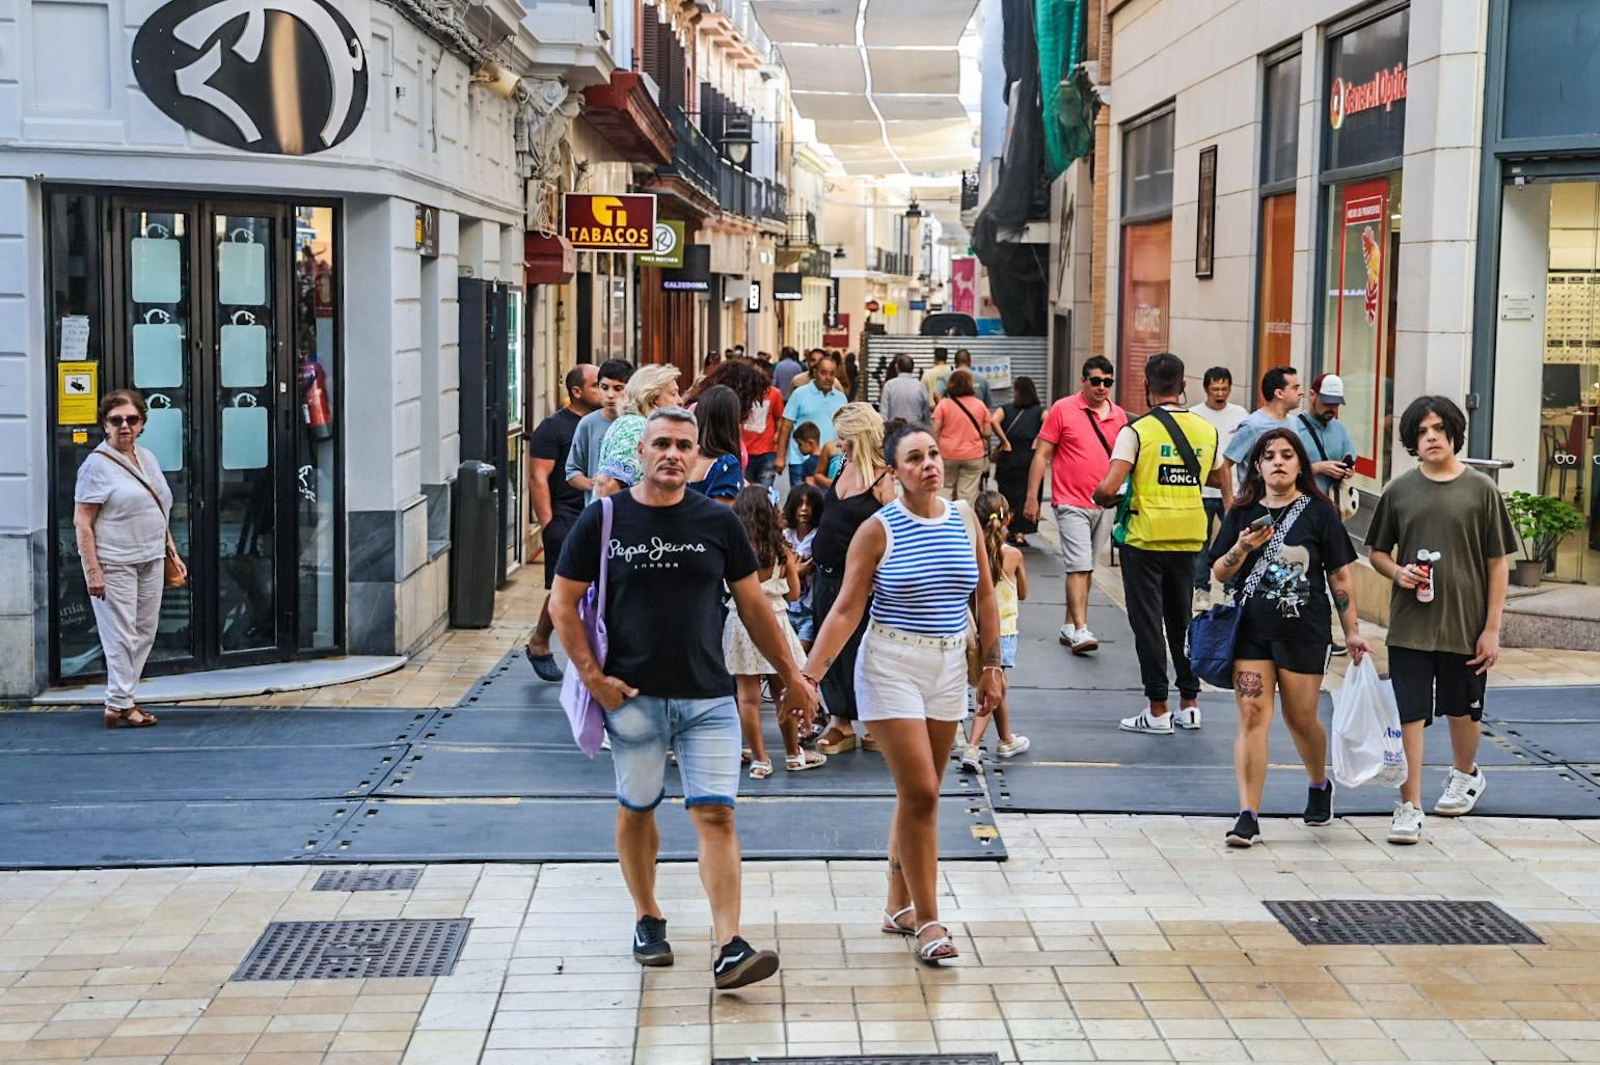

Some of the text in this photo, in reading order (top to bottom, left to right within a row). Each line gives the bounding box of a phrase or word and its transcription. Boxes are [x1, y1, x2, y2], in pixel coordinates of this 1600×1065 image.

[1345, 72, 1379, 115] General
[569, 227, 649, 244] TABACOS
[607, 536, 706, 562] Pepe Jeans
